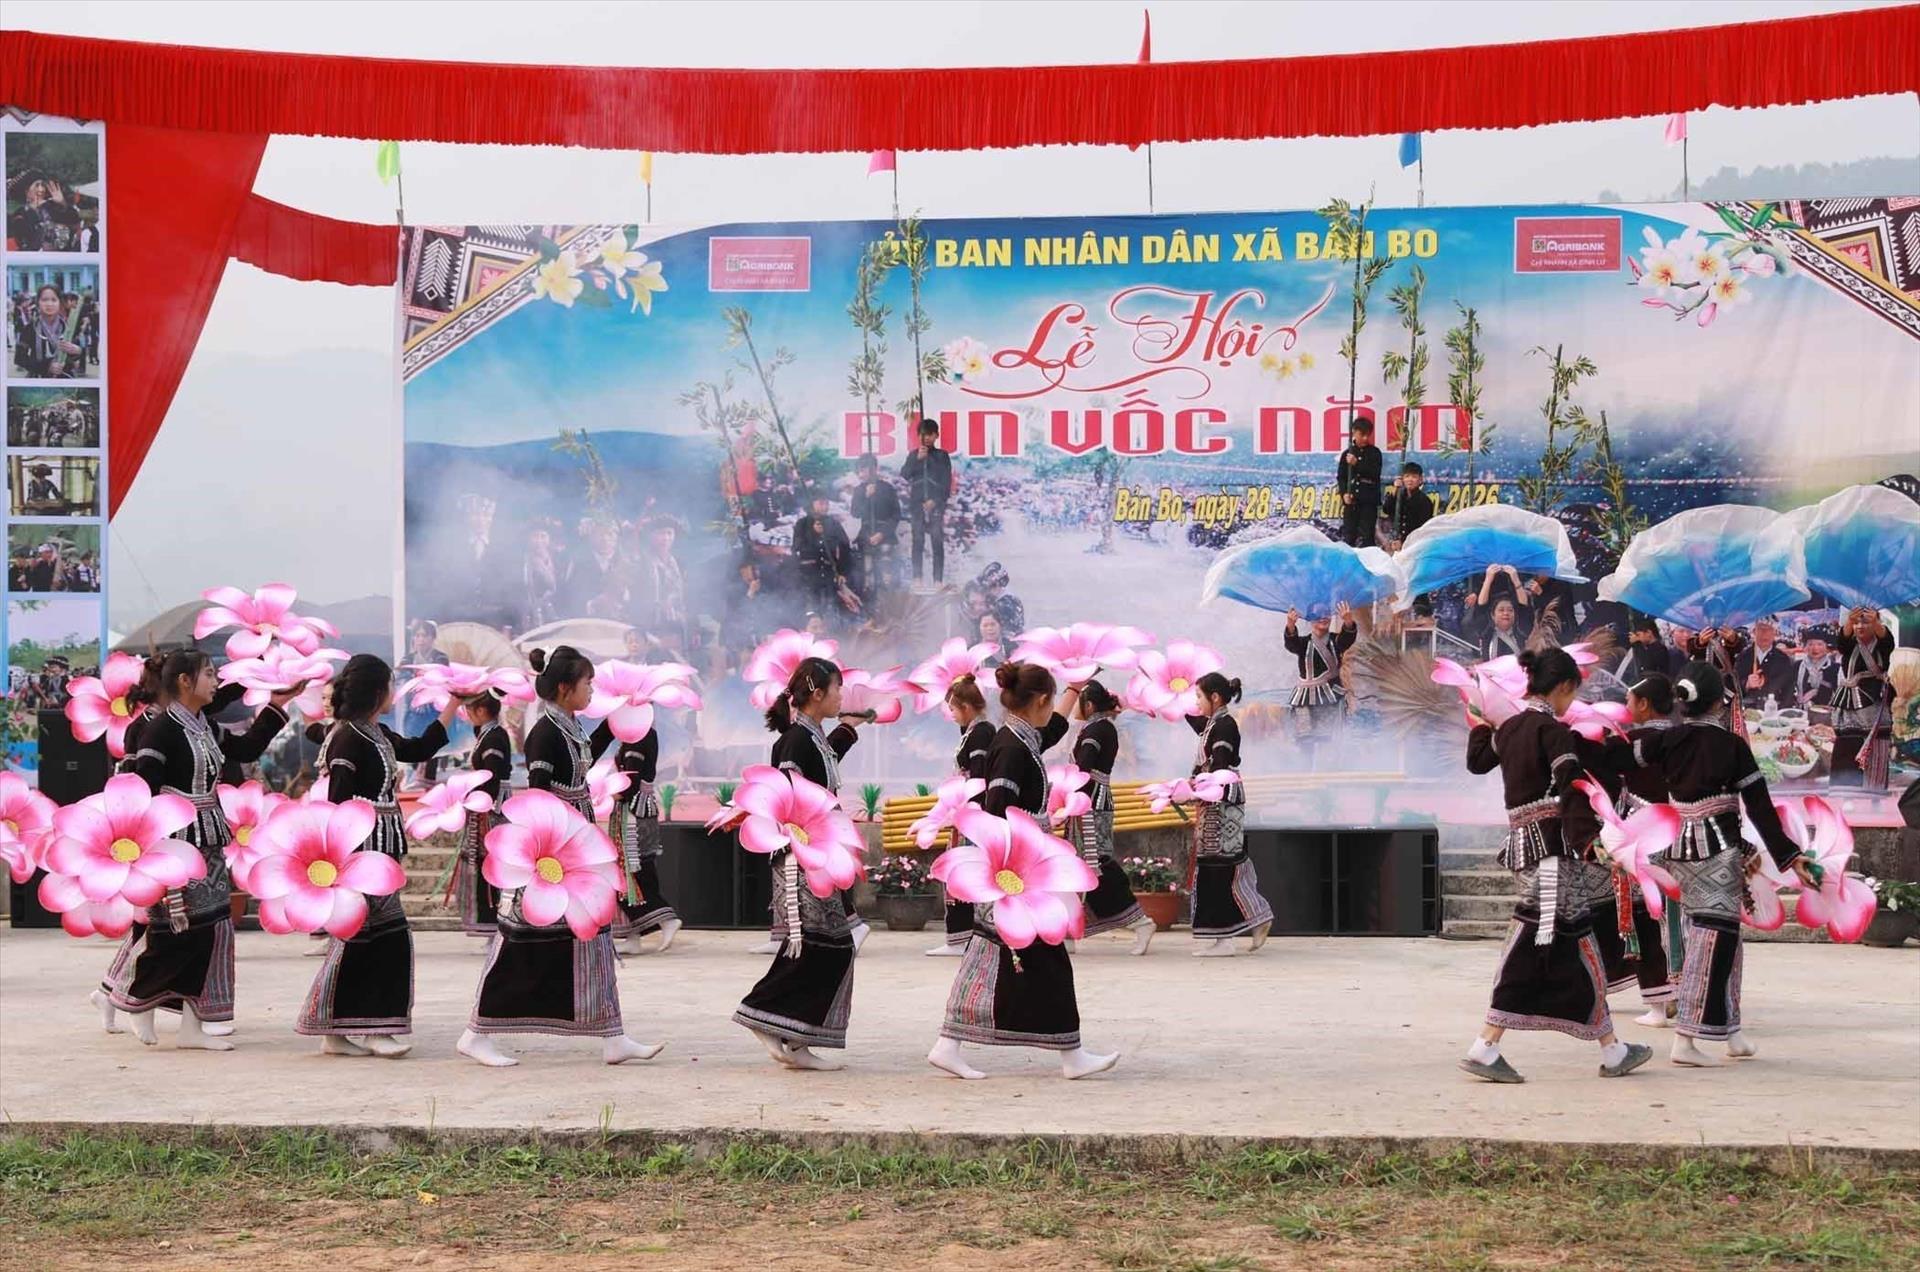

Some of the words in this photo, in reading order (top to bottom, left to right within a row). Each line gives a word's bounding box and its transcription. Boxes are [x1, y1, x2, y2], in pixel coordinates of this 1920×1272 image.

[935, 238, 1012, 267] BAN
[1024, 231, 1129, 266] NHÂN
[1142, 229, 1220, 264] DÂN
[1232, 227, 1283, 261] XÃ
[1296, 222, 1374, 260] BẢN
[1387, 229, 1438, 258] BO
[1111, 284, 1298, 367] Hội
[1051, 388, 1227, 455] VỐC
[1114, 485, 1151, 521] Bản
[1156, 487, 1186, 526] Bo,
[1193, 486, 1242, 530] ngày
[1244, 485, 1272, 520] 28
[1287, 485, 1317, 520] 29
[1445, 484, 1500, 514] 2026
